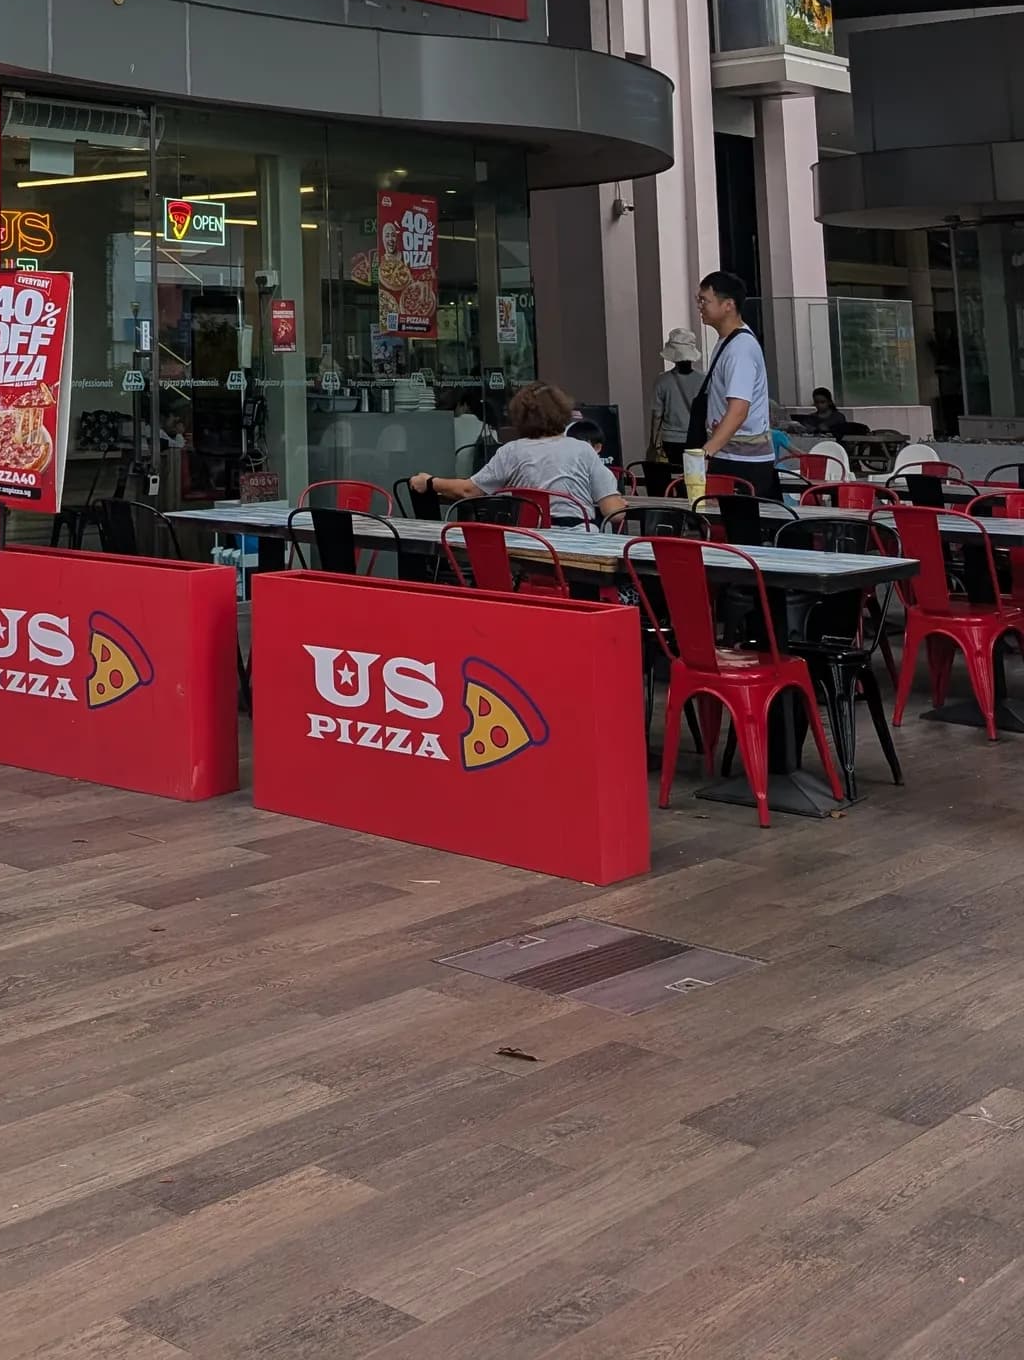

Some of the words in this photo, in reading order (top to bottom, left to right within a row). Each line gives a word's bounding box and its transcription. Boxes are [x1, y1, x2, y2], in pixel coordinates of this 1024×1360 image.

[192, 214, 223, 232] OPEN
[402, 231, 434, 251] OFF
[403, 251, 432, 268] PIZZA
[18, 276, 50, 289] EVERYDAY
[126, 372, 142, 384] US
[302, 644, 444, 720] US
[307, 713, 450, 761] PIZZA
